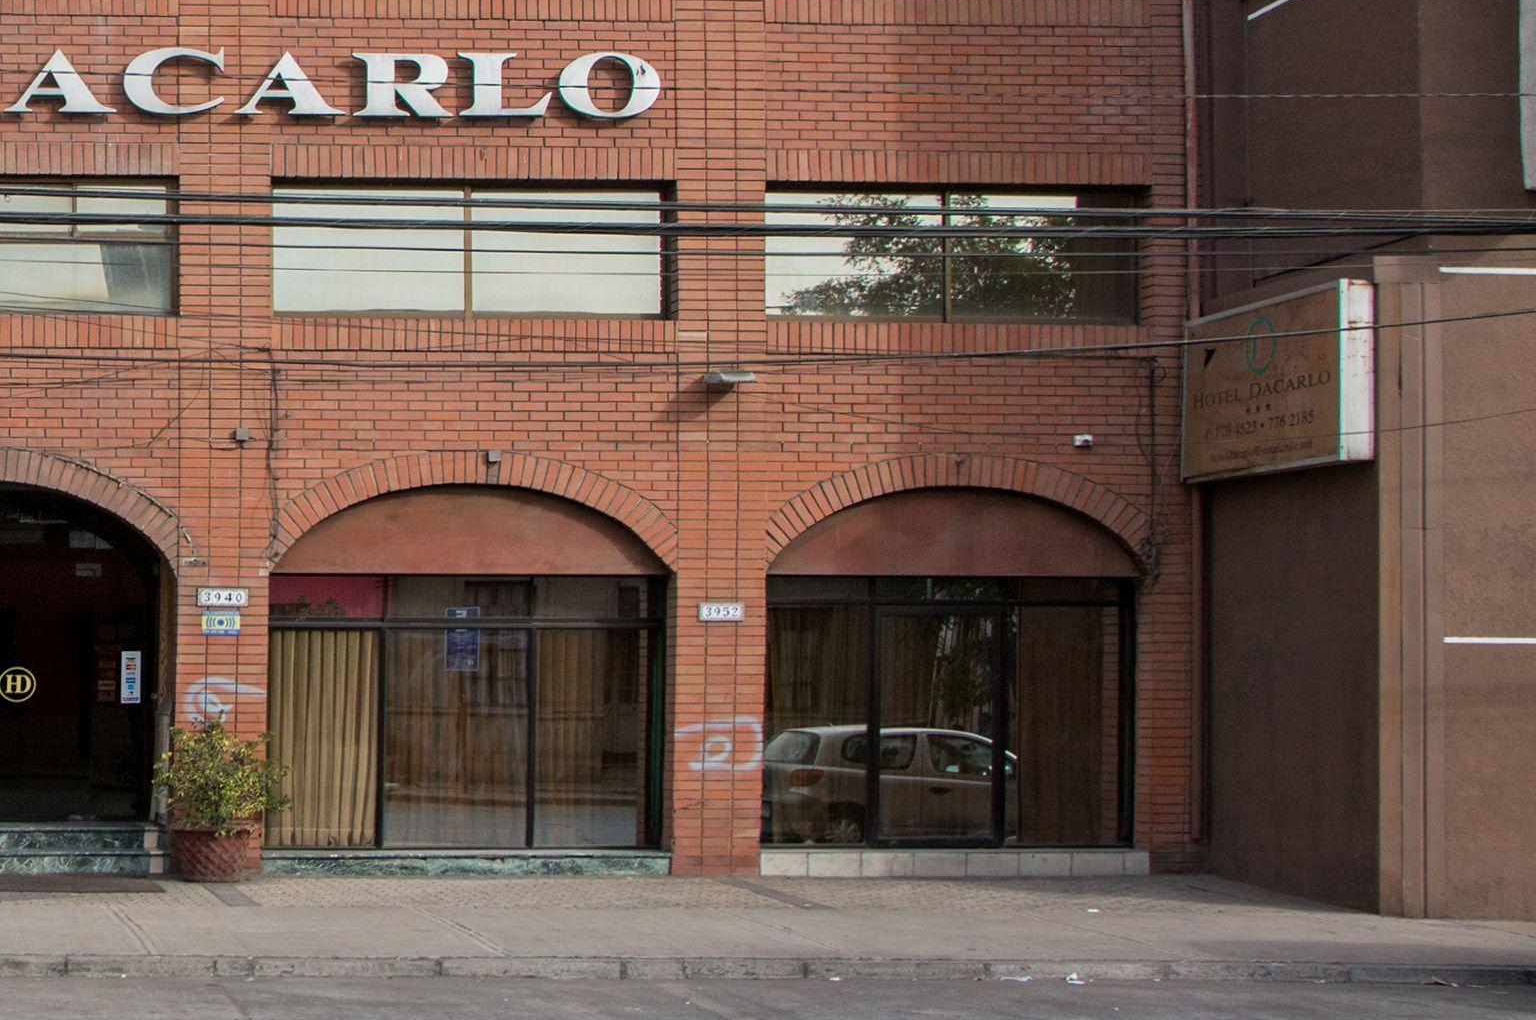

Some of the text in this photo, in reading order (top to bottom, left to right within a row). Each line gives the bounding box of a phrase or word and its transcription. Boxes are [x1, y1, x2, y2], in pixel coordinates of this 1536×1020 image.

[1192, 371, 1331, 410] HOTEL DACARLO
[204, 592, 242, 603] 3940
[705, 606, 739, 617] 3952
